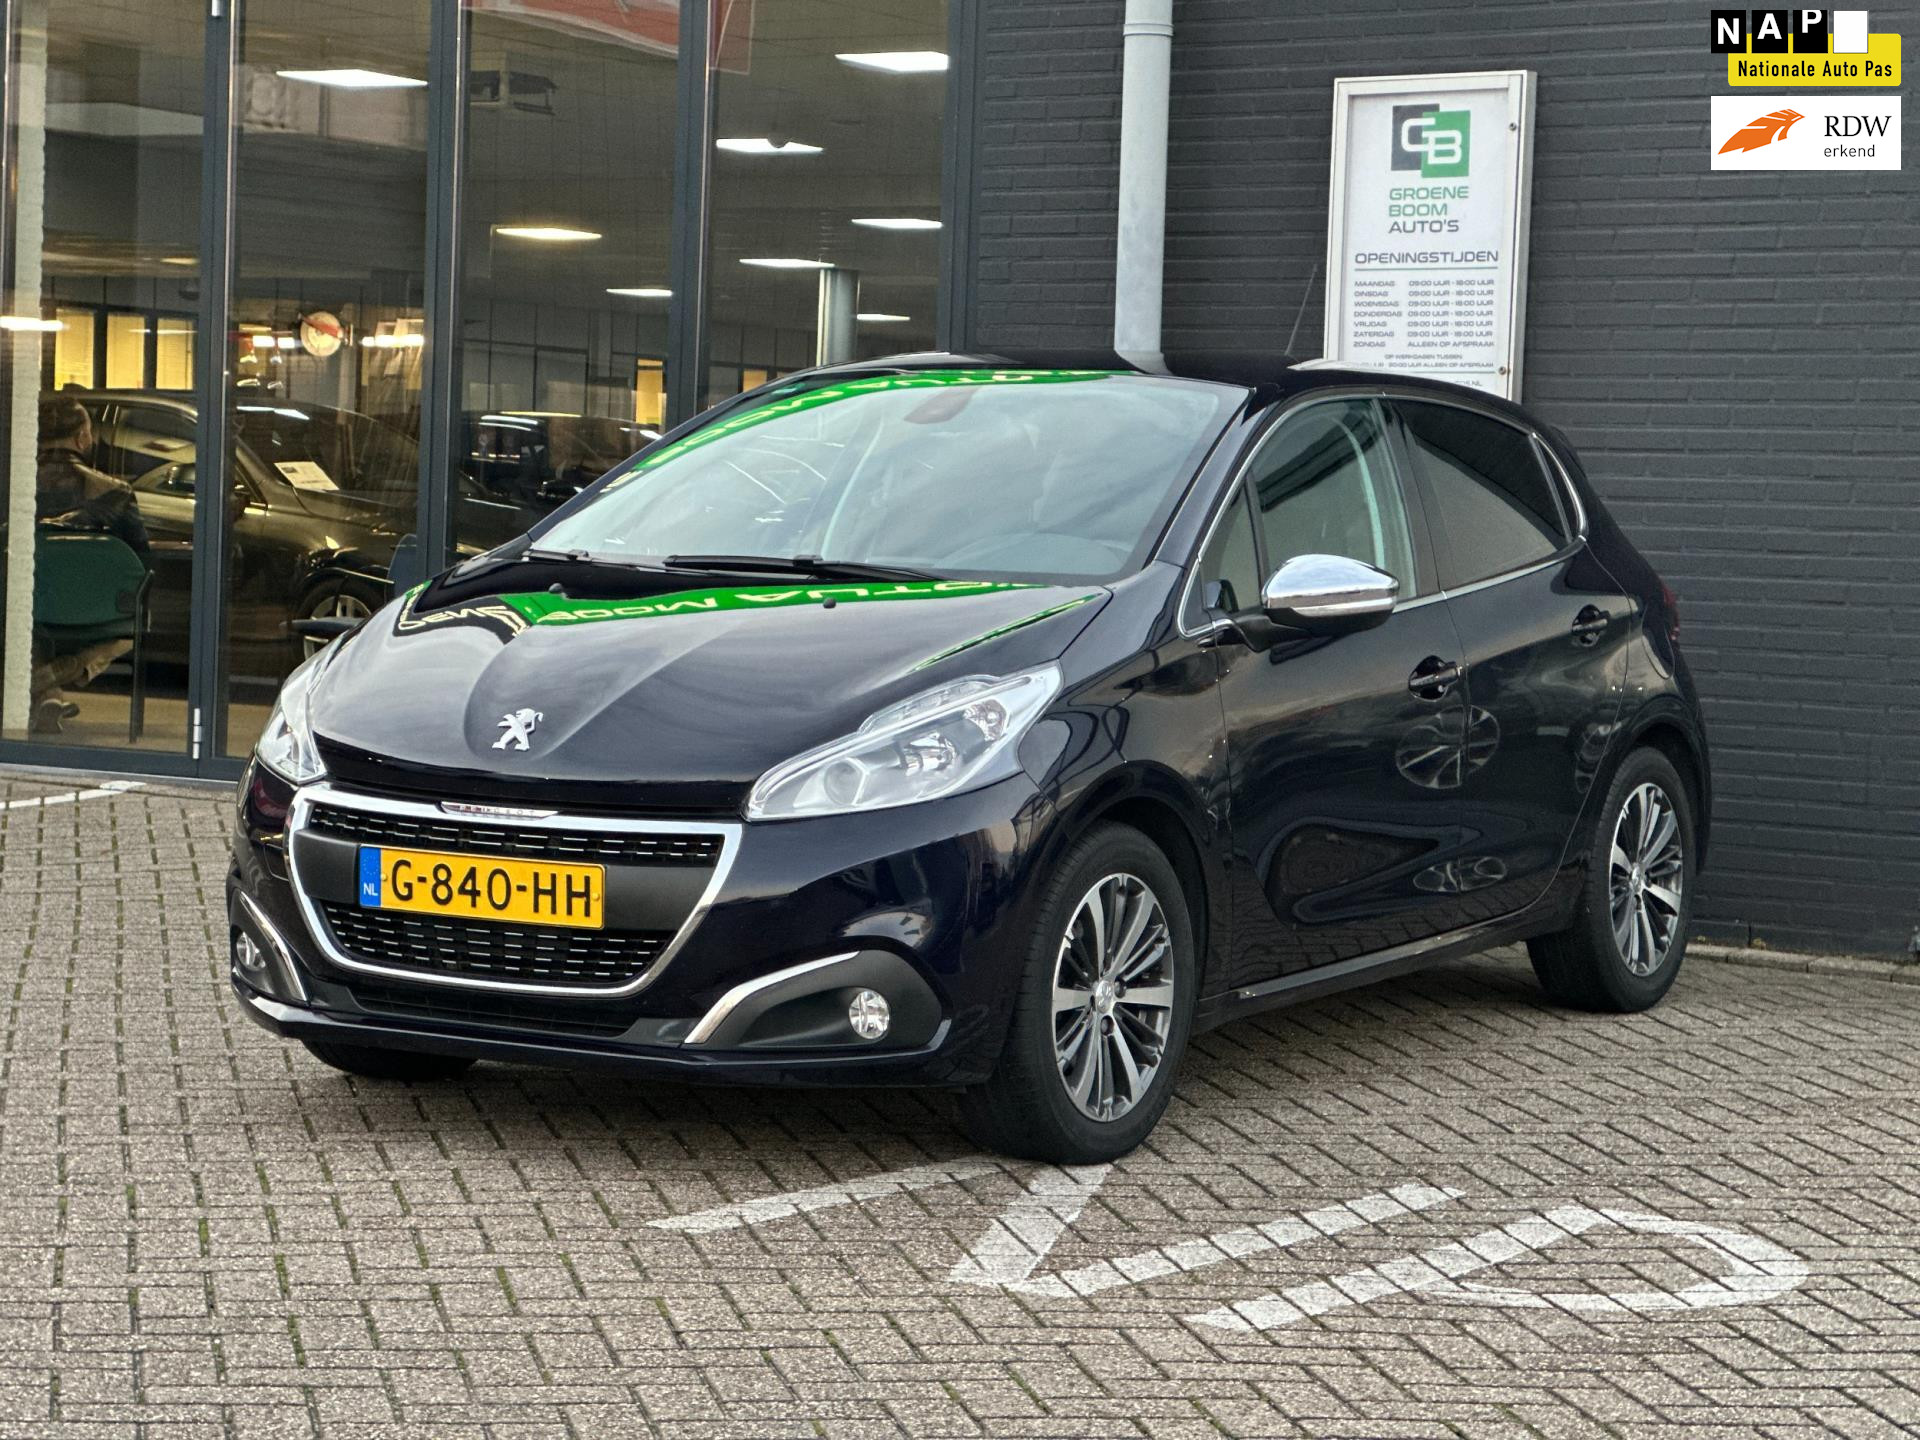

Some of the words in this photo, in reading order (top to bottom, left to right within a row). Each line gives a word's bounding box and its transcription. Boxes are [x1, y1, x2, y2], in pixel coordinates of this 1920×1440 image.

[1389, 186, 1470, 201] GROENE
[1388, 203, 1448, 218] BOOM
[1388, 219, 1460, 234] AUTO'S
[1354, 250, 1499, 265] OPENINGSTIJDEN
[363, 882, 379, 897] NL
[391, 858, 592, 918] G-840-HH
